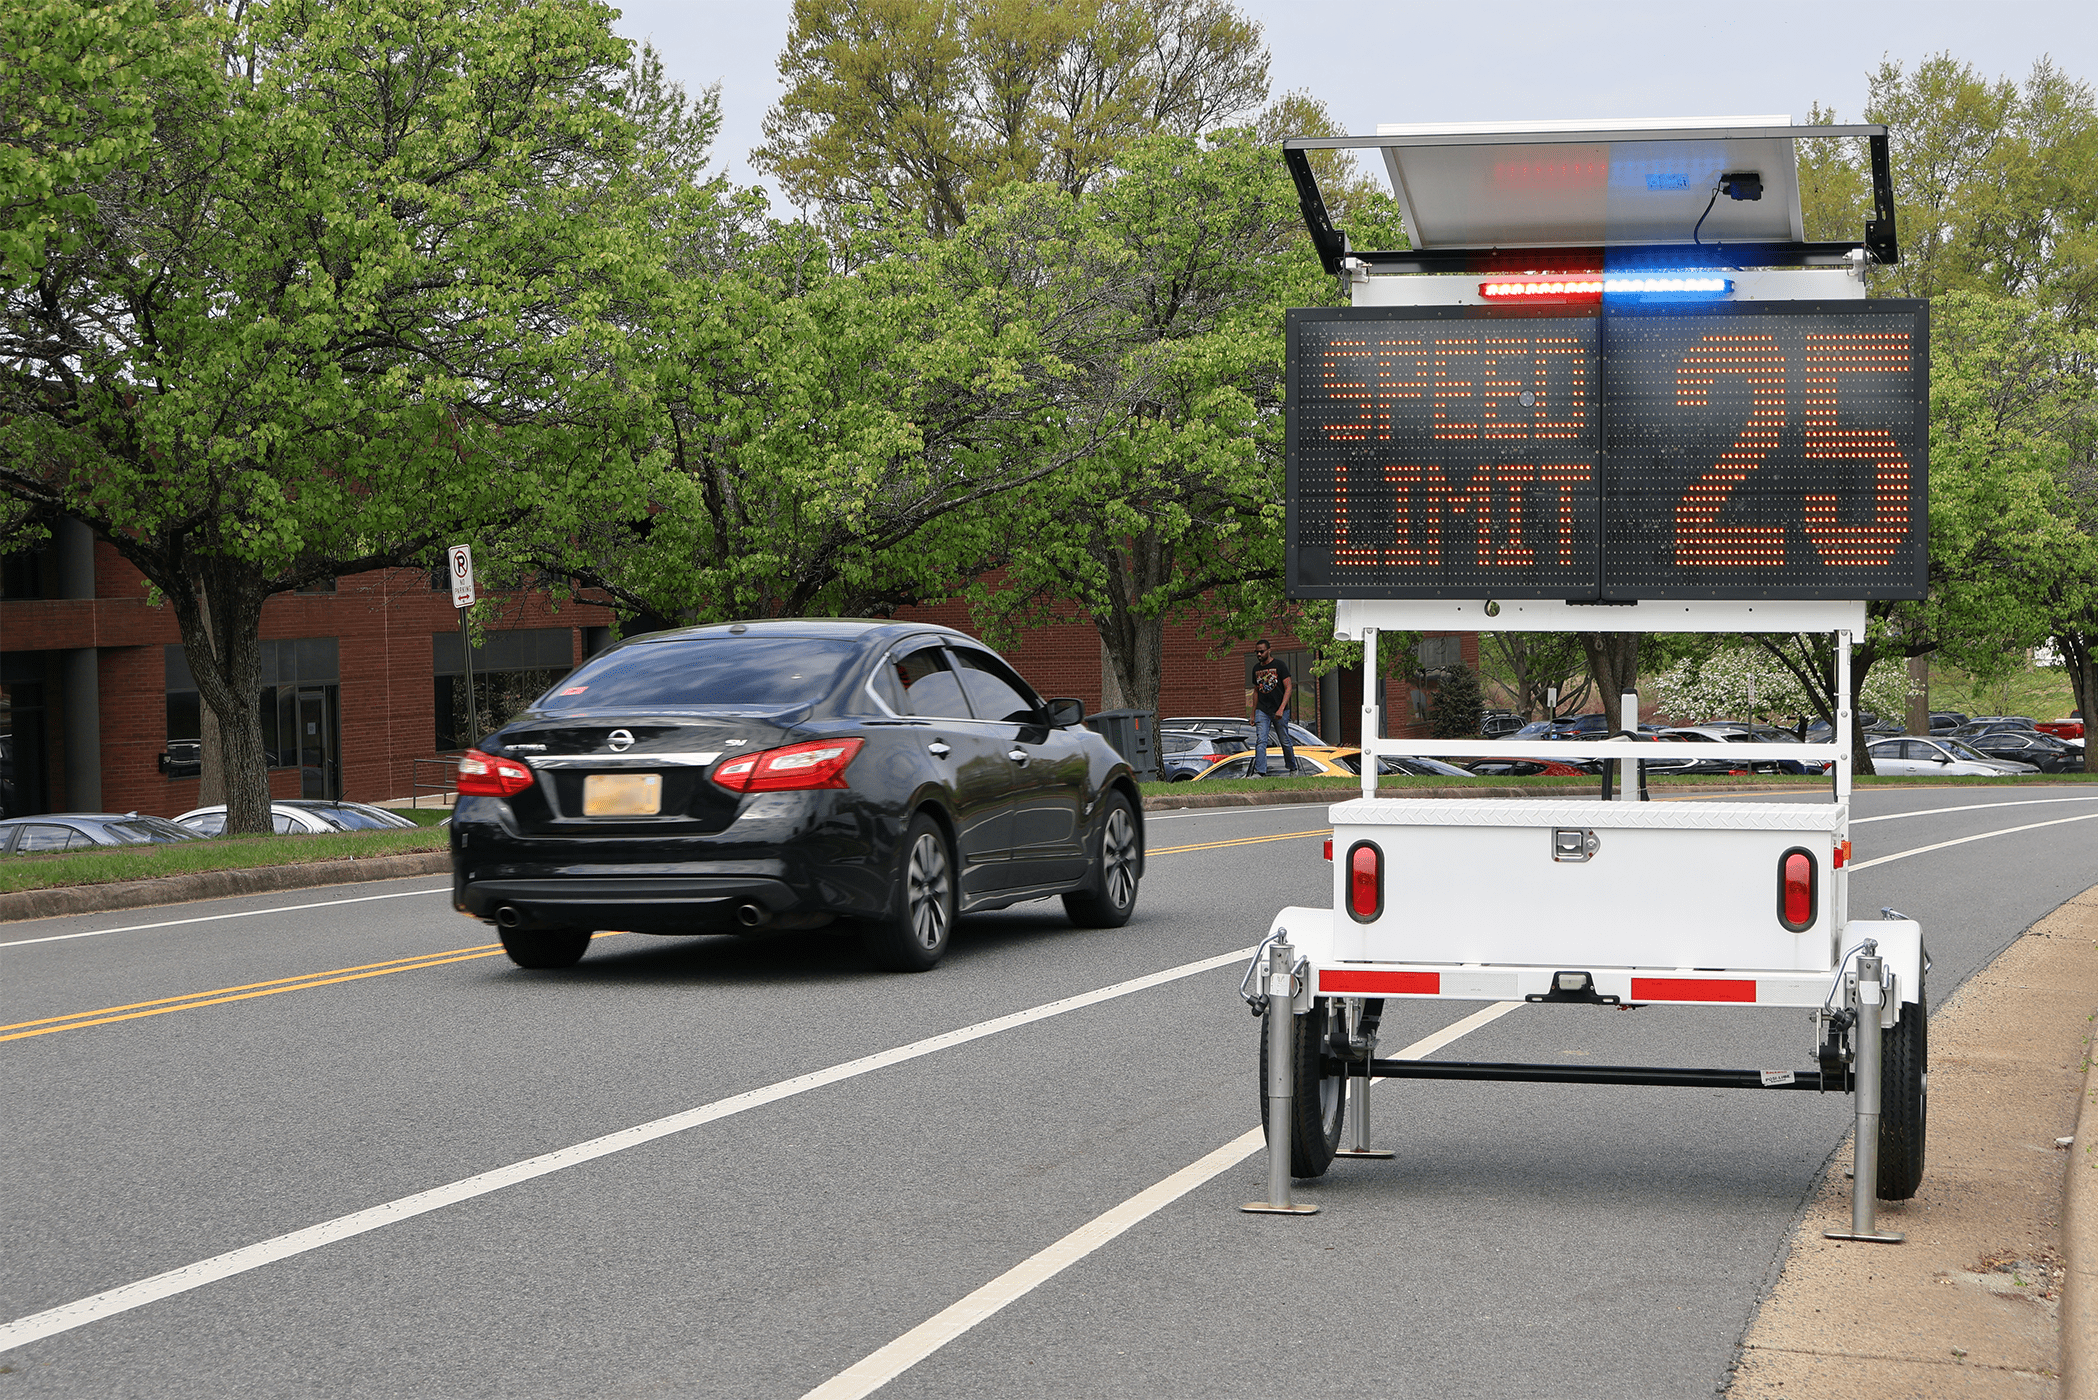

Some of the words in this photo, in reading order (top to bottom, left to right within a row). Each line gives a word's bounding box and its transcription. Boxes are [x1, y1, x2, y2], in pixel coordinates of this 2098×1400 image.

[1323, 337, 1586, 441] SPEED
[1675, 332, 1911, 567] 25
[1335, 463, 1592, 567] LIMIT
[725, 739, 748, 747] SV
